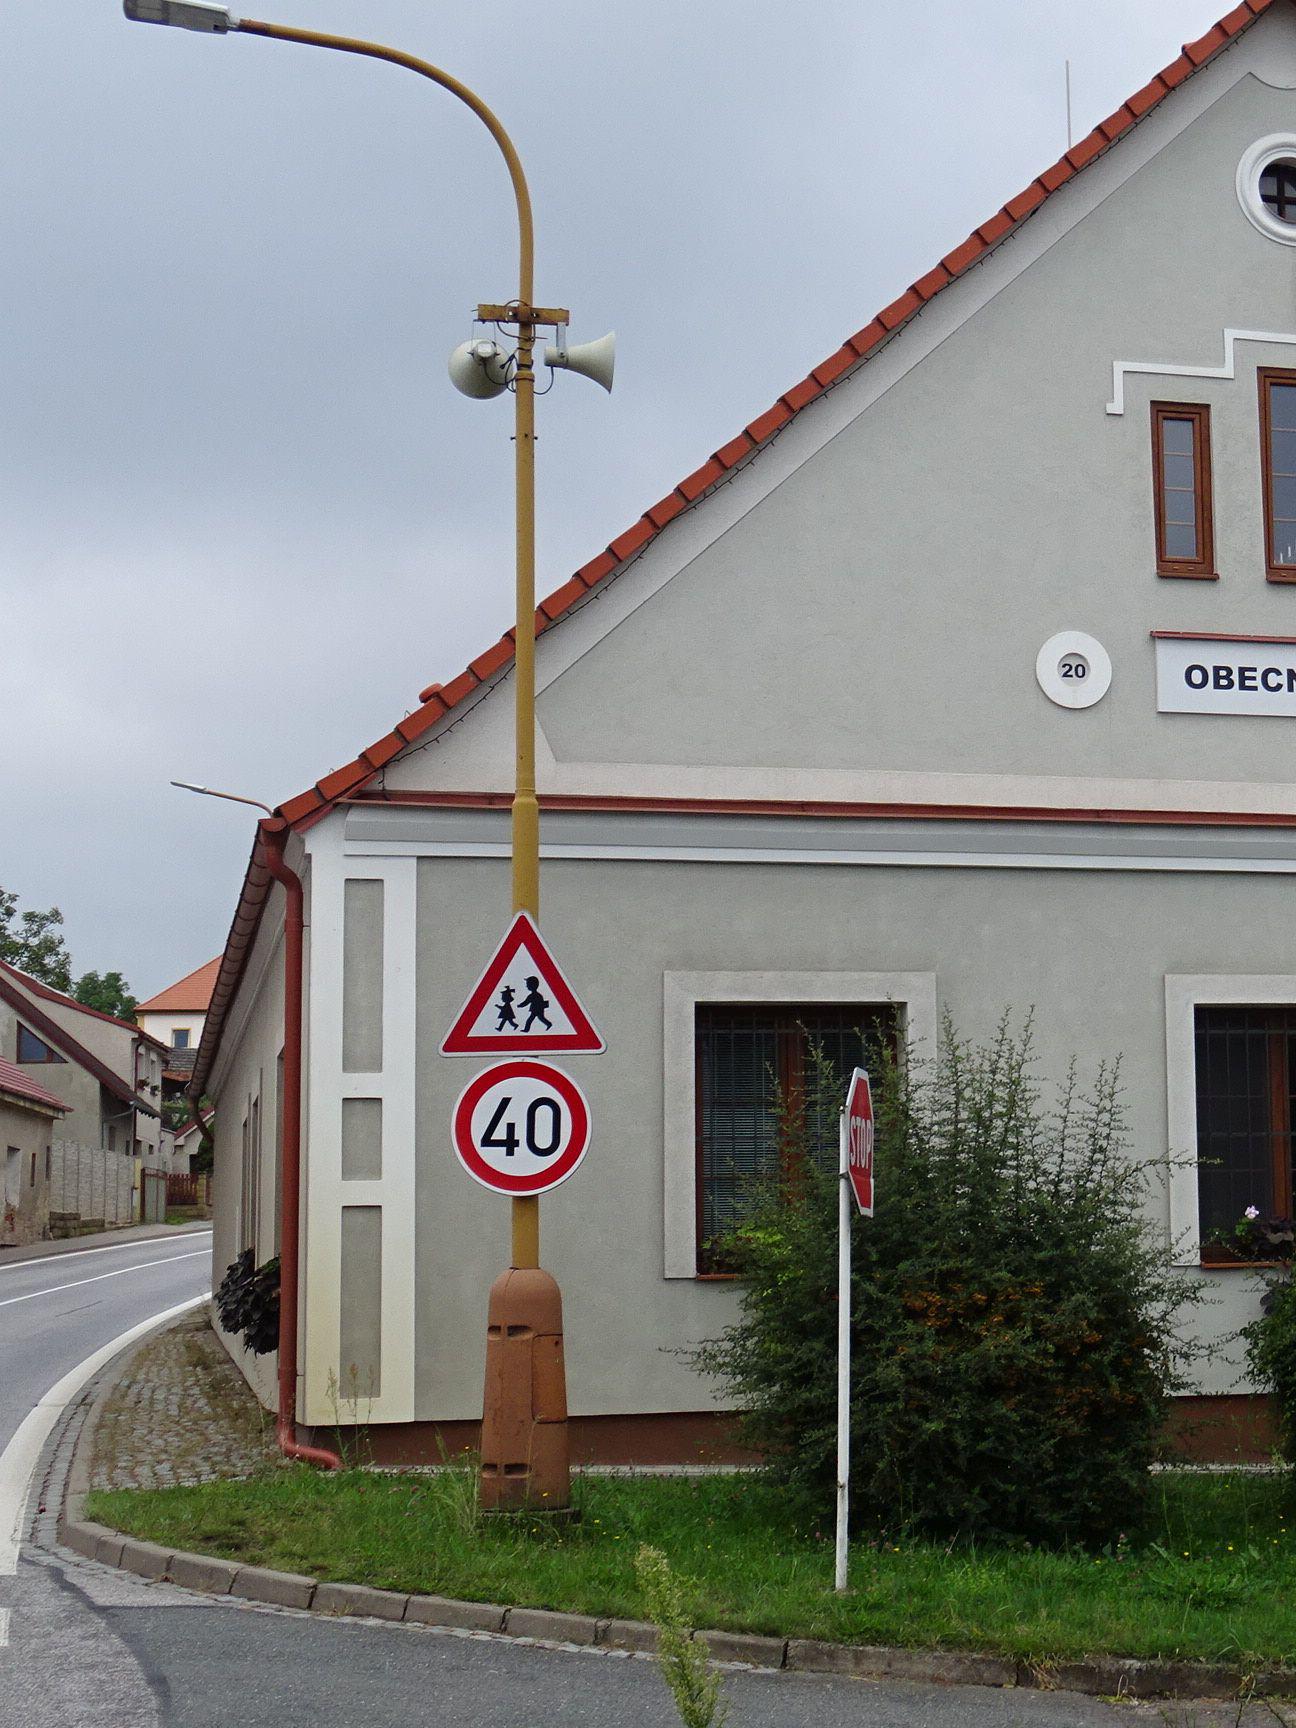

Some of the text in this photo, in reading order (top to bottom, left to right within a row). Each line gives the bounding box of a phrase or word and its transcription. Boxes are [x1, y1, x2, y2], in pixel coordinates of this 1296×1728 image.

[1061, 663, 1086, 678] 20
[480, 1096, 562, 1158] 40
[850, 1115, 873, 1169] STOP
